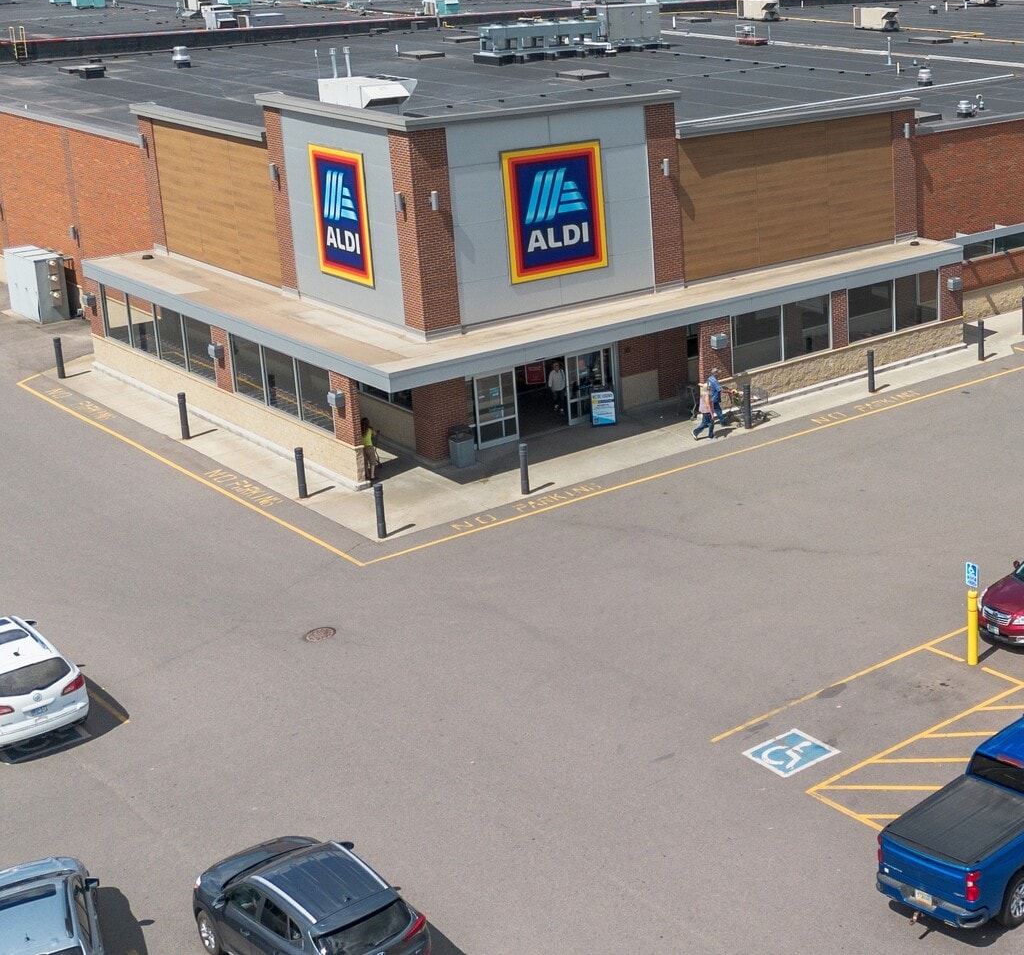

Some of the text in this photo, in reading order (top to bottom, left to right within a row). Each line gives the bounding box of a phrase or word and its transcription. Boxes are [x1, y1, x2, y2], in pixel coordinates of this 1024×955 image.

[326, 225, 361, 255] ALDI
[527, 222, 590, 253] ALDI
[203, 468, 238, 483] NO
[451, 482, 602, 531] NO PARKING
